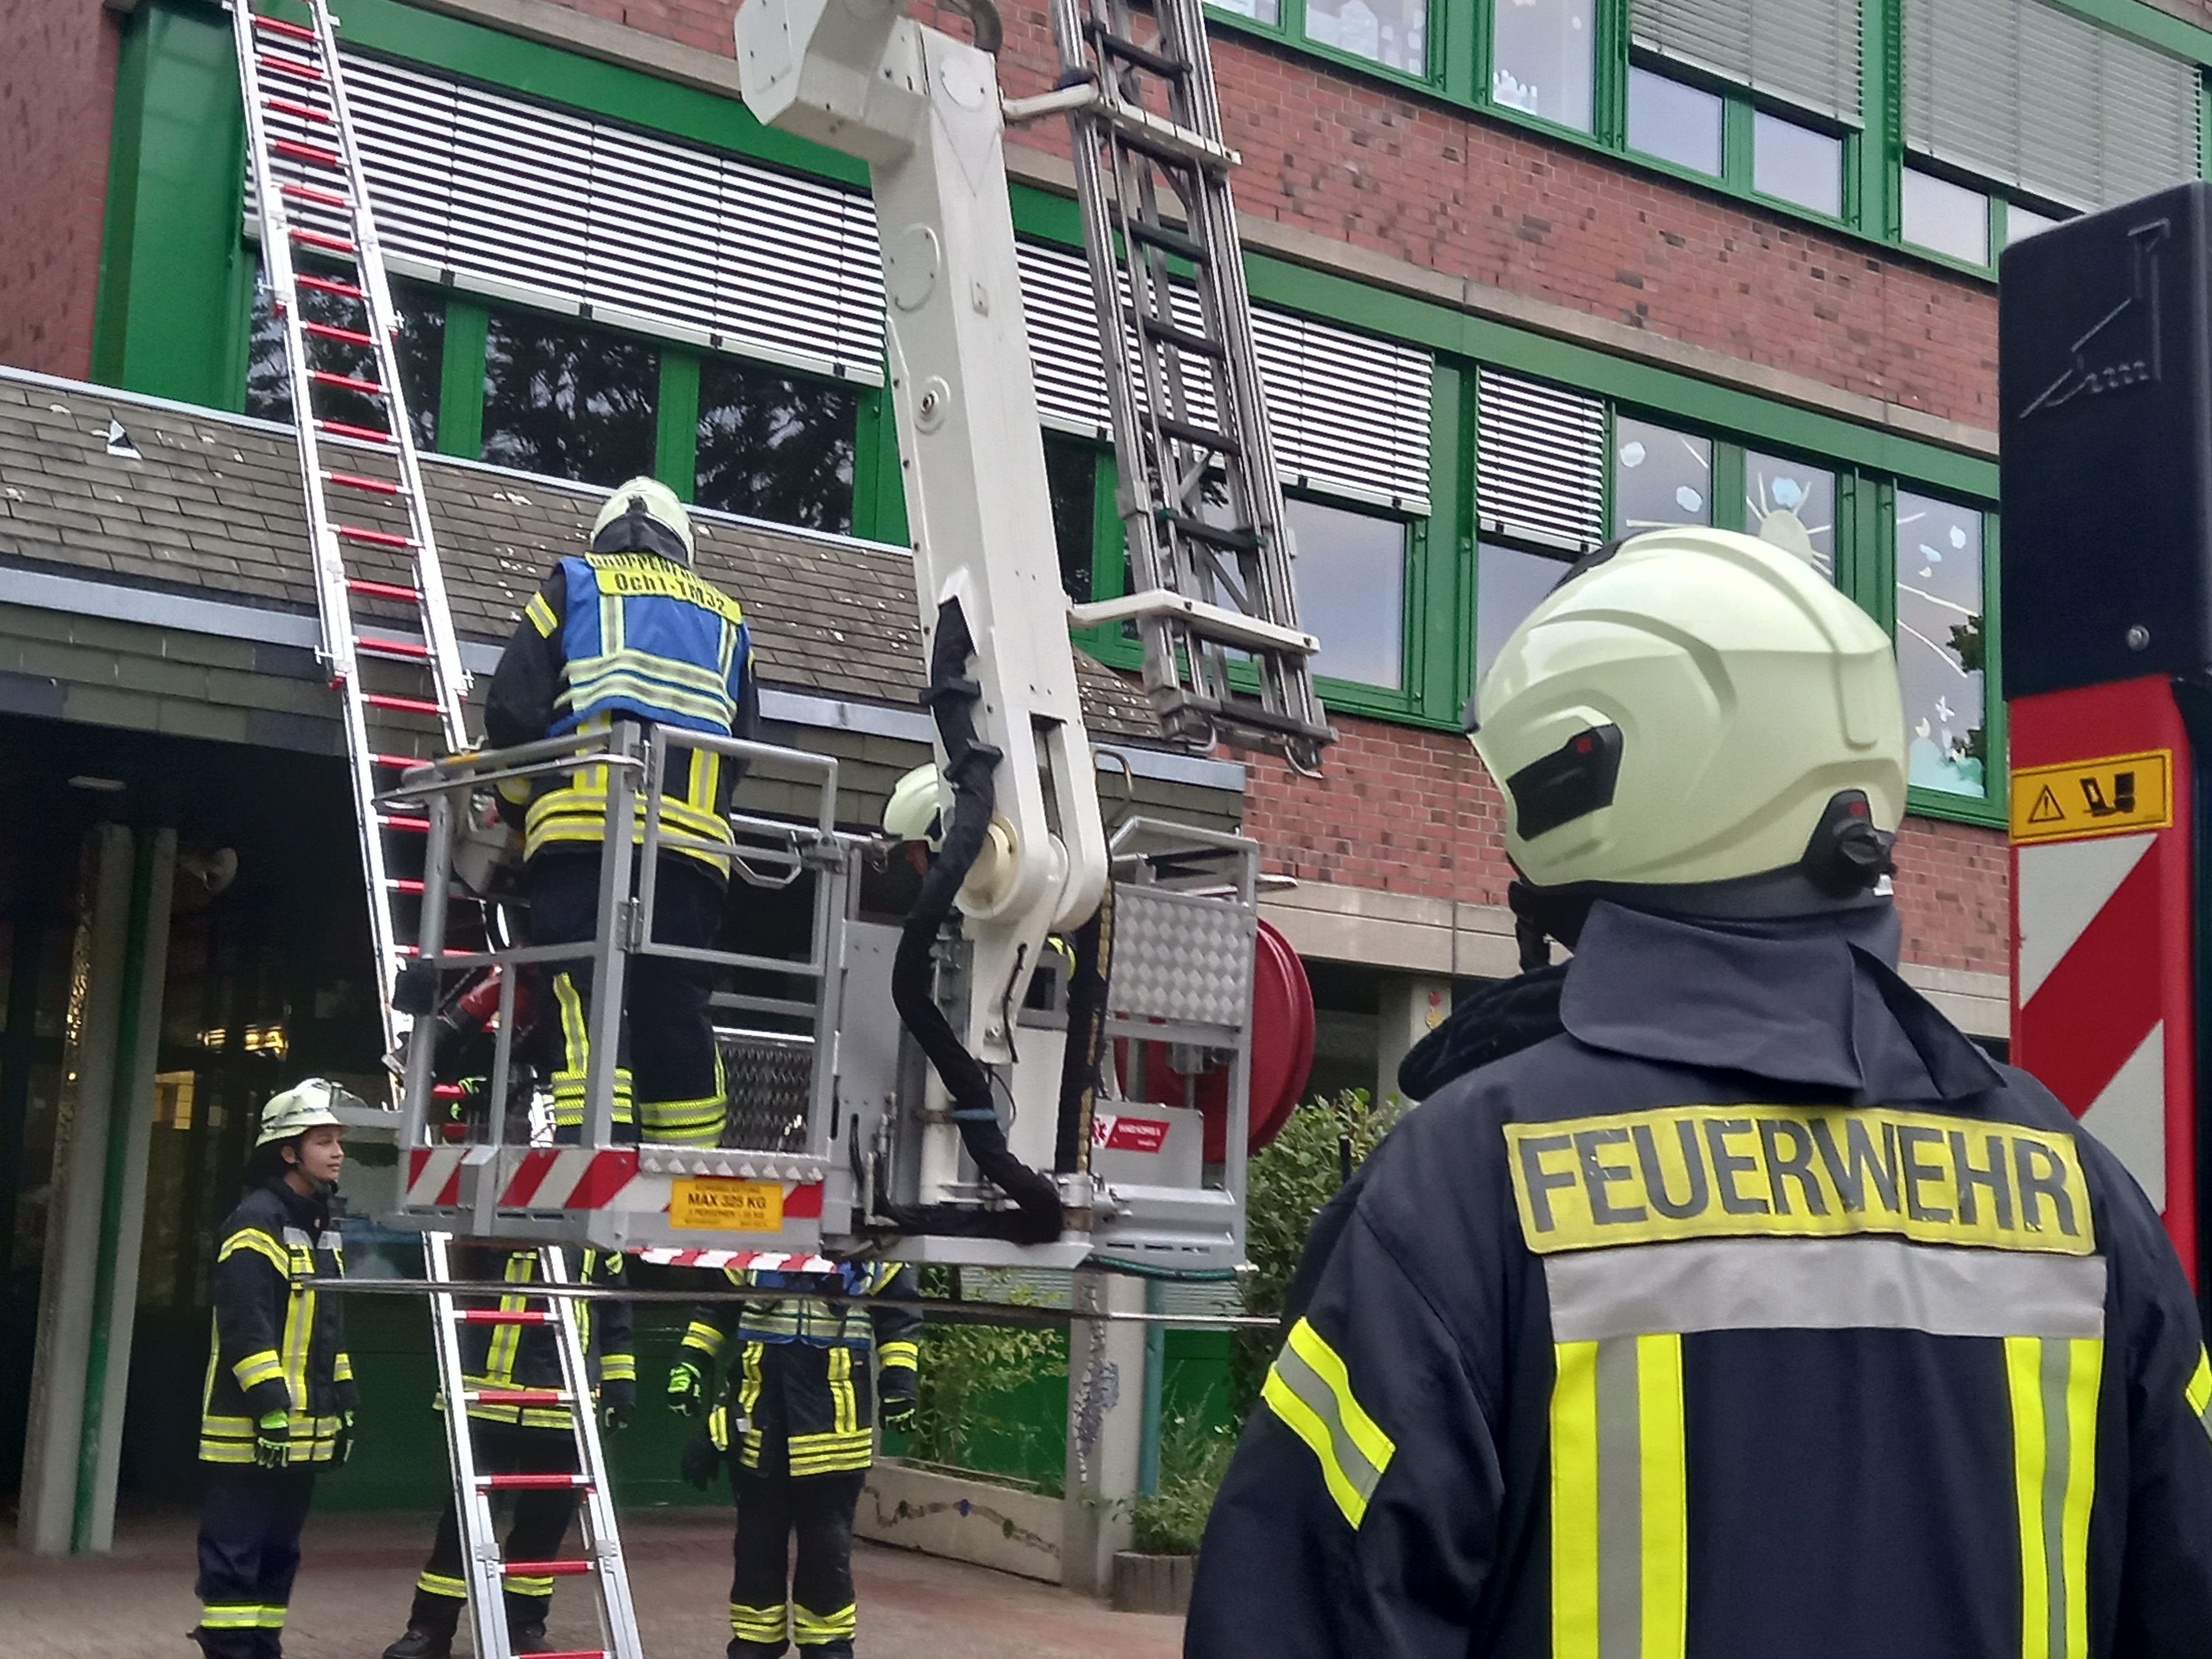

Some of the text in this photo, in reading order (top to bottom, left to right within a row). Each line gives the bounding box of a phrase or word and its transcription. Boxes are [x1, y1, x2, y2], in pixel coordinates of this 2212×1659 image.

[688, 1193, 718, 1207] MAX
[747, 1196, 766, 1209] KG
[1519, 1118, 2081, 1238] FEUERWEHR
